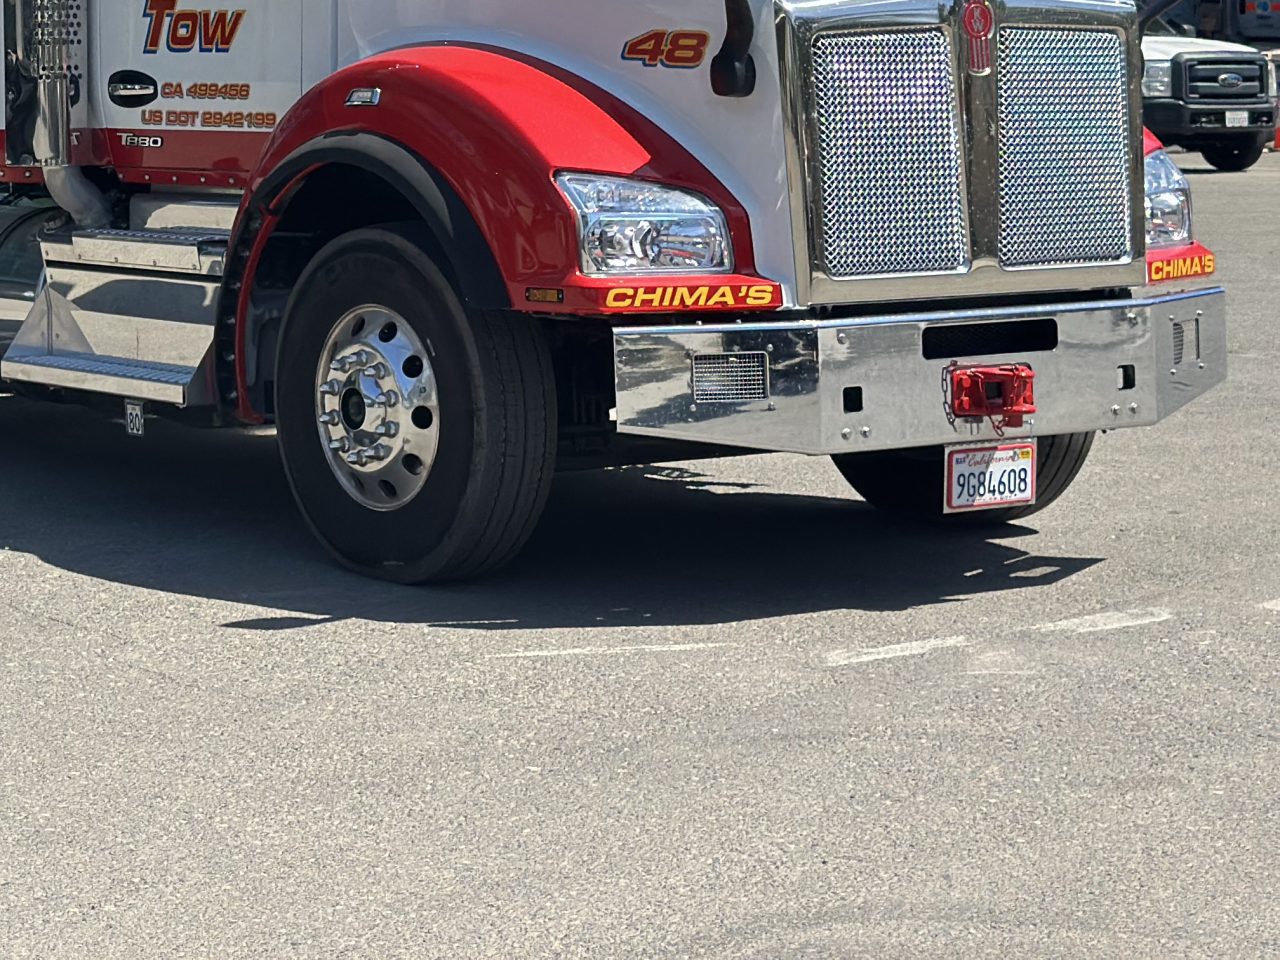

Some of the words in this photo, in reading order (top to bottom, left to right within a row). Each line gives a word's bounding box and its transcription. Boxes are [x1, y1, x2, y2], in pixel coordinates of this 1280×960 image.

[621, 28, 710, 69] 48
[161, 82, 184, 99] CA
[186, 83, 251, 100] 499456
[141, 109, 163, 126] US
[165, 110, 199, 127] DOT
[200, 111, 277, 128] 2942199
[116, 132, 163, 148] T880
[1151, 254, 1214, 281] CHIMA'S
[605, 284, 774, 308] CHIMA'S
[129, 411, 140, 433] 80
[956, 467, 1028, 500] 9G84608
